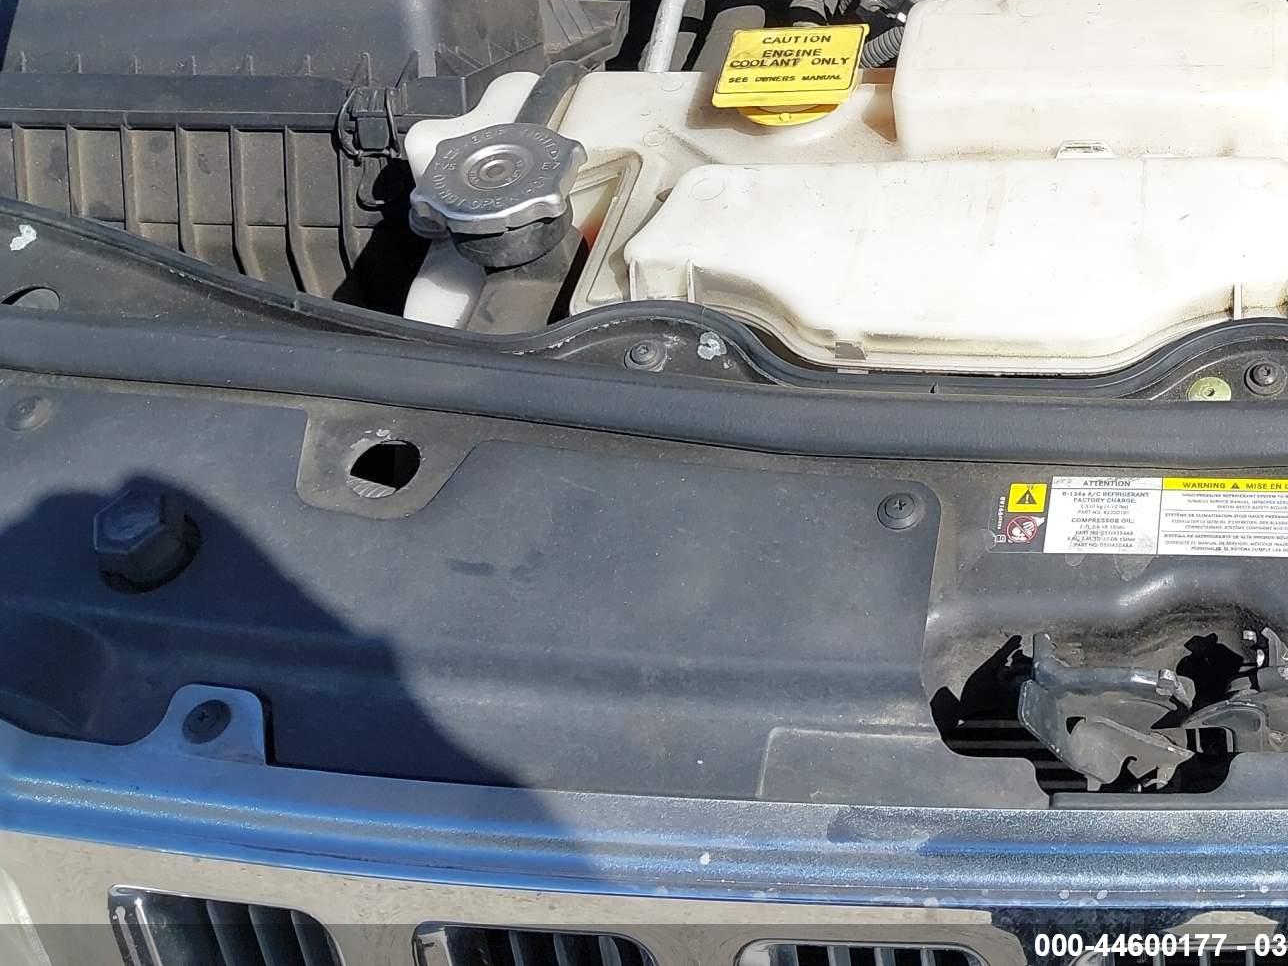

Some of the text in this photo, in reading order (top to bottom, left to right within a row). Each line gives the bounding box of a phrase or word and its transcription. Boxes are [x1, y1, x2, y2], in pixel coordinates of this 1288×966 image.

[762, 35, 832, 44] CAUTION
[762, 48, 823, 58] ENGINE
[729, 57, 850, 68] COOLANT ONLY
[1182, 481, 1226, 489] WARNING
